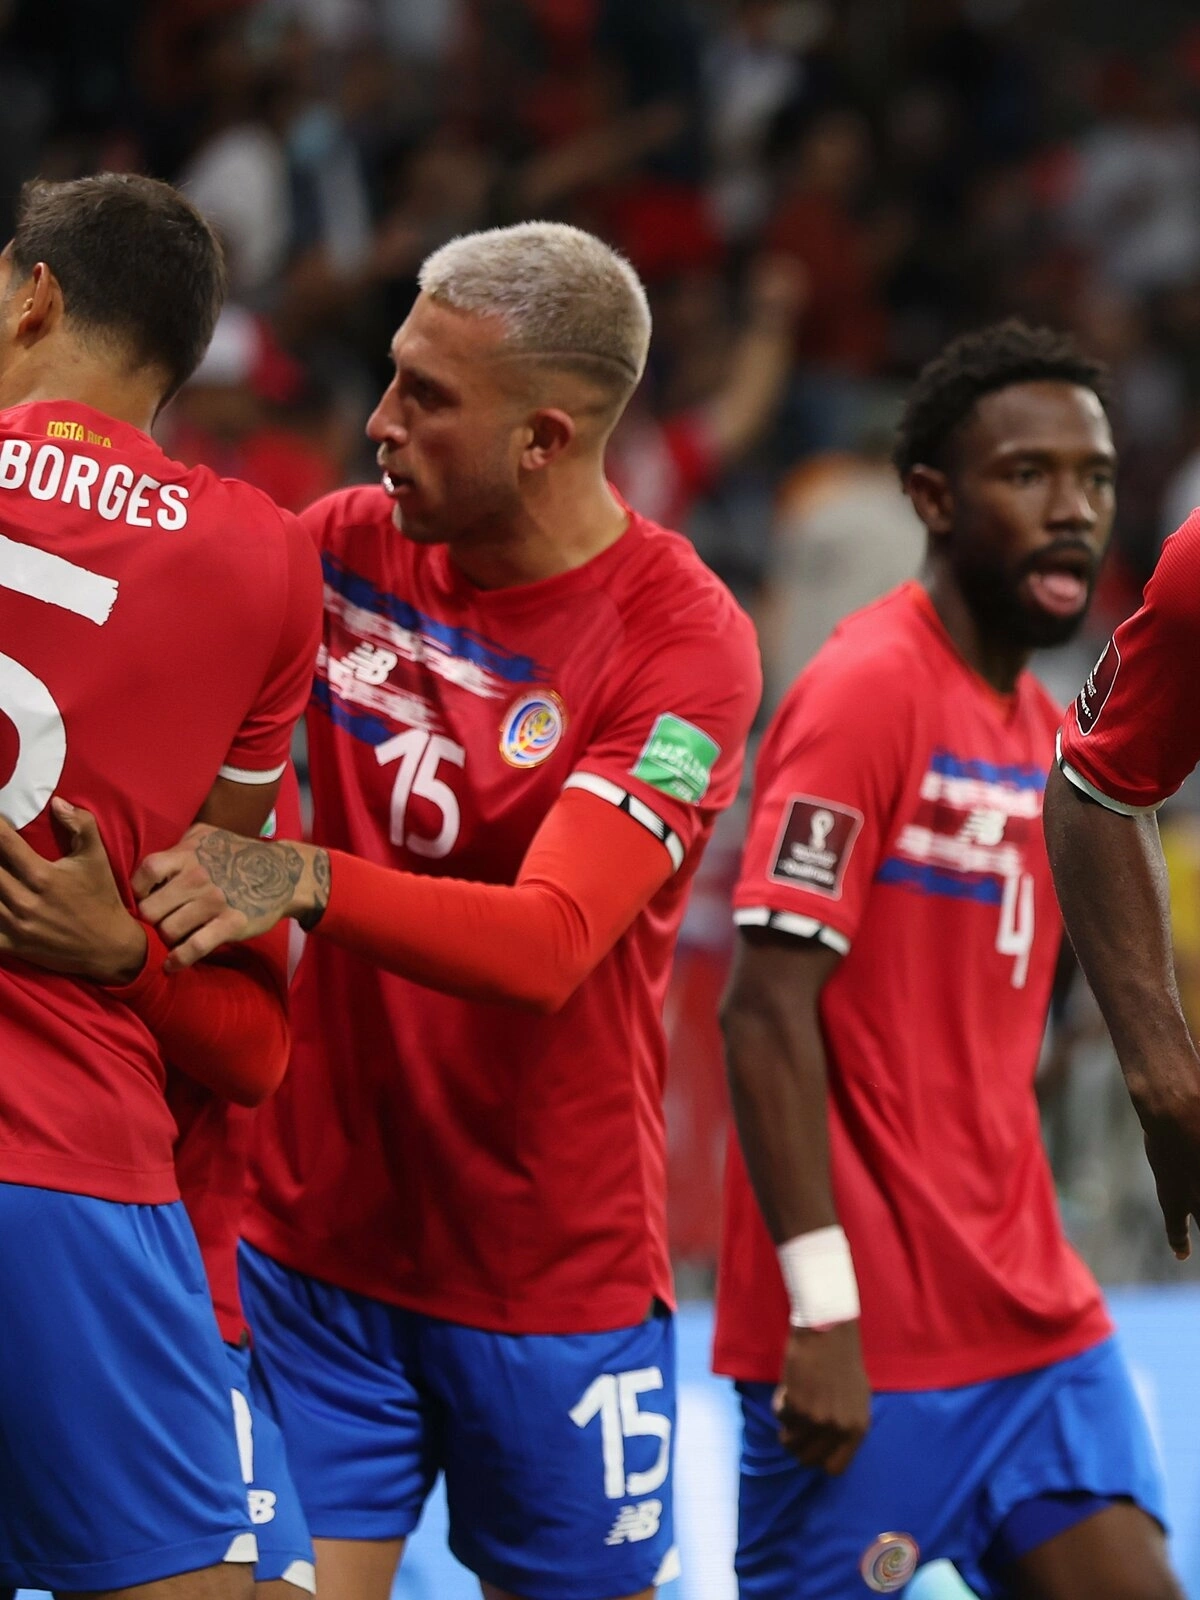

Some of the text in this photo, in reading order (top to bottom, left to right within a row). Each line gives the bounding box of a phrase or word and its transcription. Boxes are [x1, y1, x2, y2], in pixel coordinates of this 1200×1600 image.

[0, 439, 189, 531] BORGES
[46, 421, 84, 441] COSTA
[374, 728, 466, 860] 15
[995, 862, 1036, 989] 4
[568, 1366, 672, 1499] 15
